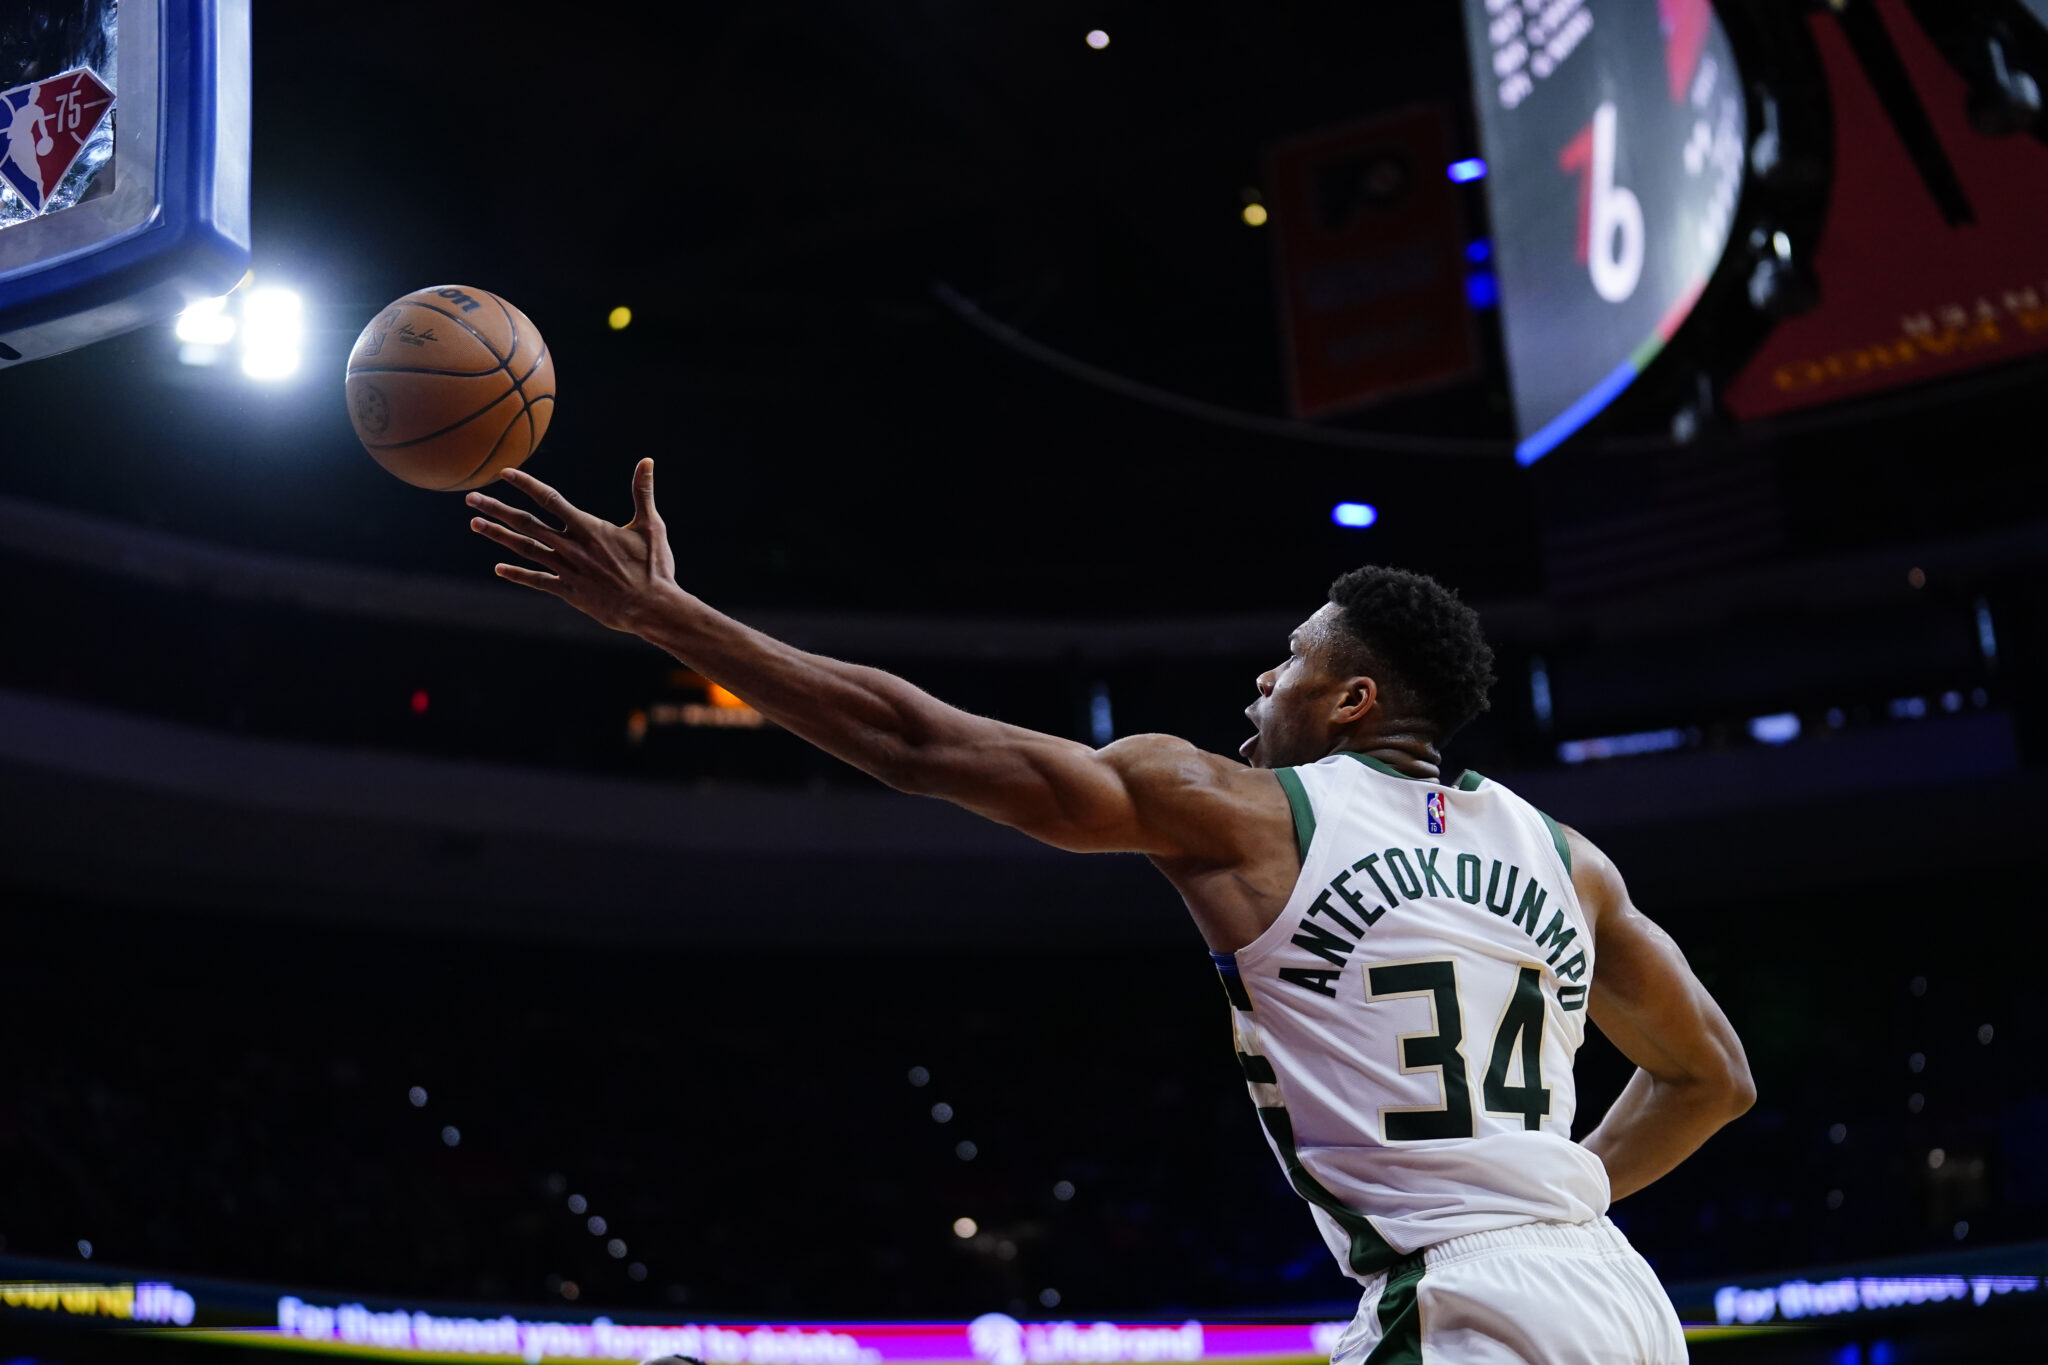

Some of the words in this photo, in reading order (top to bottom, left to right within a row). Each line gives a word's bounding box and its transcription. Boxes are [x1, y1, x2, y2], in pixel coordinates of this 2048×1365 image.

[56, 90, 81, 133] 75
[1430, 822, 1438, 832] 75
[1278, 847, 1588, 1012] ANTETOKOUNMPO
[1362, 955, 1554, 1143] 34
